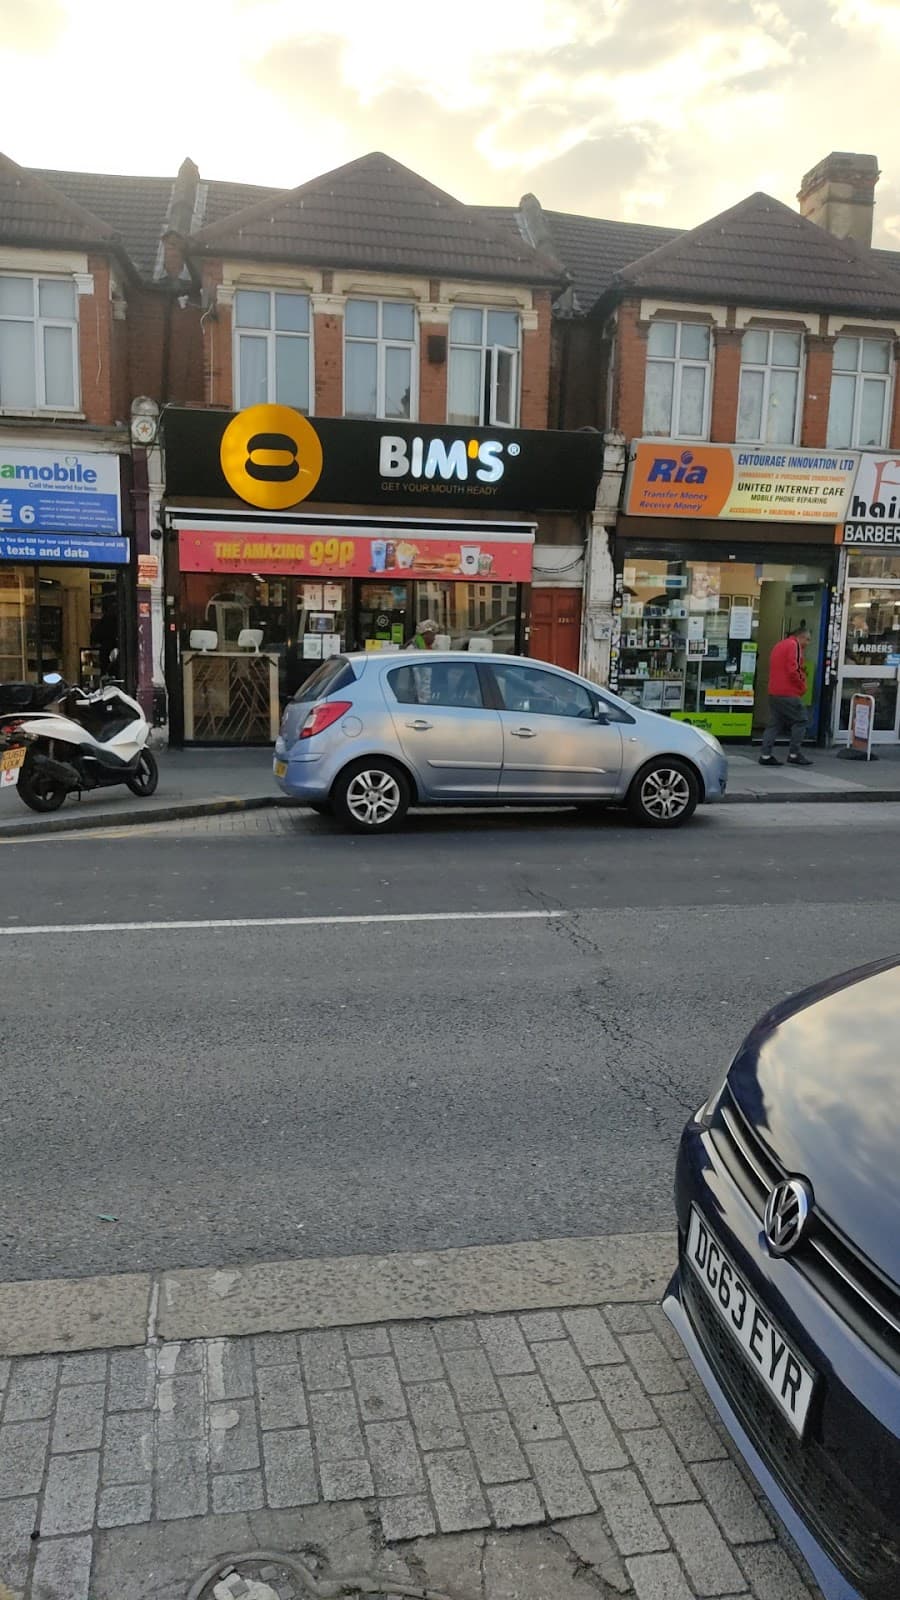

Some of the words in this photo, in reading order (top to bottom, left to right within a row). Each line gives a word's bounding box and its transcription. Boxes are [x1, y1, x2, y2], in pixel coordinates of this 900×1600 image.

[647, 450, 708, 484] Ria
[738, 454, 787, 468] ENTOURAGE
[788, 456, 838, 470] INNOVATION
[839, 459, 855, 471] LTD
[381, 482, 400, 492] GET
[402, 483, 430, 493] YOUR
[431, 484, 465, 495] MOUTH
[467, 485, 499, 496] READY
[643, 490, 678, 499] Transfer
[680, 491, 708, 502] Money
[737, 482, 772, 493] UNITED
[774, 484, 820, 495] INTERNET
[822, 486, 845, 497] CAFE
[640, 500, 671, 509] Receive
[673, 501, 703, 511] Money
[750, 494, 773, 502] MOBILE
[774, 495, 795, 503] PHONE
[796, 496, 828, 505] REPAIRING
[852, 496, 900, 518] hai
[19, 504, 35, 524] 6
[7, 544, 36, 556] texts
[39, 547, 61, 557] and
[64, 548, 90, 559] data
[215, 542, 241, 559] THE
[243, 543, 305, 561] AMAZING
[852, 643, 893, 653] BARBERS
[694, 1221, 748, 1331] DG63
[749, 1306, 802, 1415] EYR
